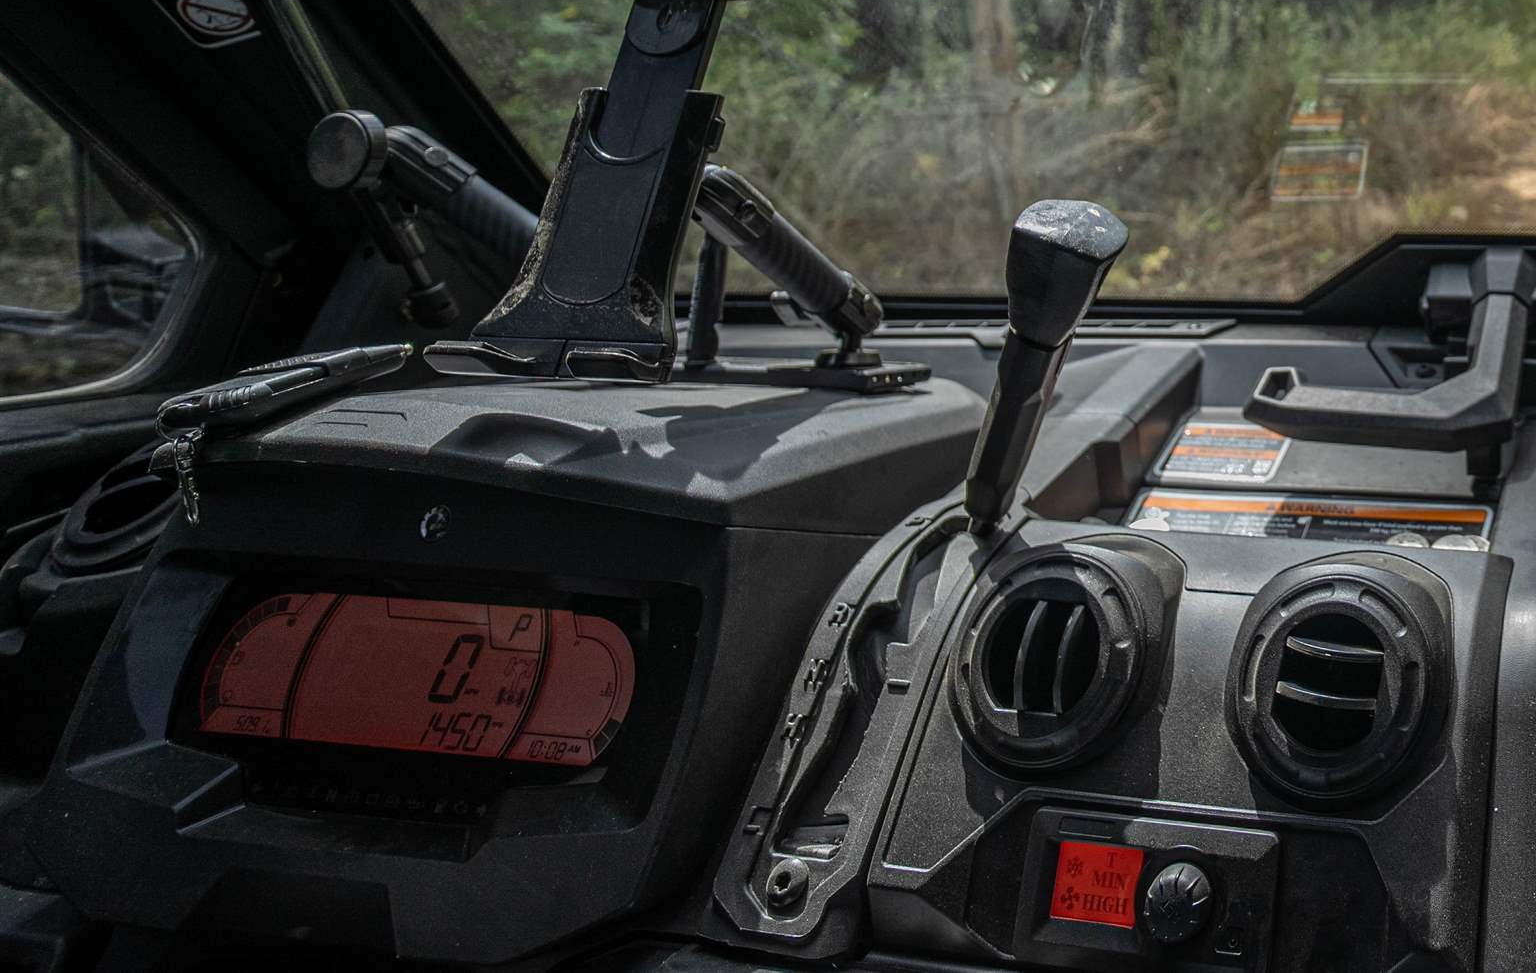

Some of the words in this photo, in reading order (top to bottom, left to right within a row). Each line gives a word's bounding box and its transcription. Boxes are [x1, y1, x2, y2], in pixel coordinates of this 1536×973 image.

[508, 613, 533, 642] P
[428, 633, 484, 704] 0
[419, 712, 492, 751] 1450
[527, 739, 567, 760] 10:08
[1092, 870, 1129, 890] MIN
[1082, 892, 1129, 915] HIGH
